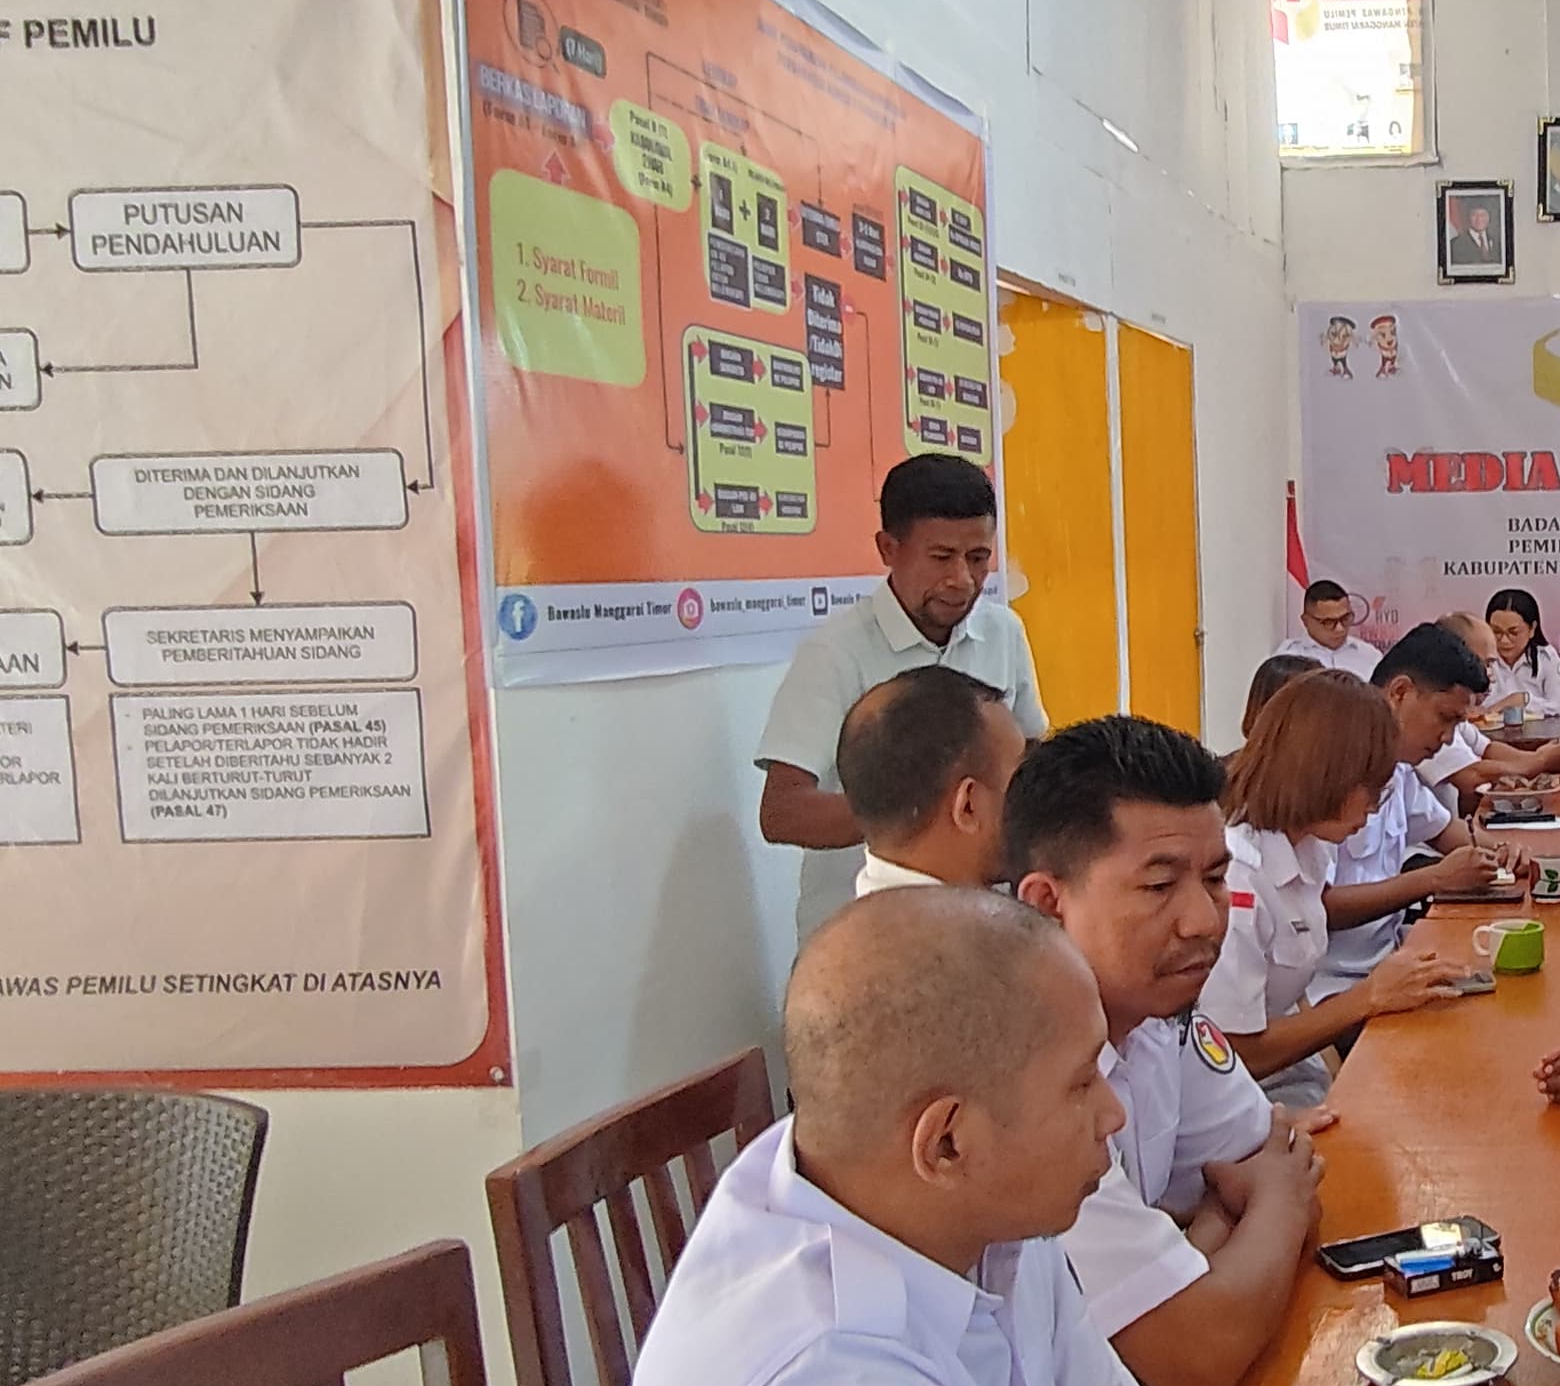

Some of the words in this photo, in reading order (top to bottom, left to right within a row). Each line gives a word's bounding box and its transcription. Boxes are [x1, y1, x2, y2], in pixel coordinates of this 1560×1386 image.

[23, 15, 156, 48] PEMILU
[480, 64, 531, 107] BERKAS
[124, 201, 244, 226] PUTUSAN
[91, 230, 281, 256] PENDAHULUAN
[517, 242, 530, 267] 1.
[533, 245, 577, 280] Syarat
[535, 283, 578, 314] Syarat
[134, 467, 211, 483] DITERIMA
[214, 466, 248, 482] DAN
[251, 464, 361, 481] DILANJUTKAN
[183, 486, 251, 501] DENGAN
[255, 484, 316, 499] SIDANG
[194, 502, 309, 518] PEMERIKSAAN
[1443, 560, 1557, 576] KABUPATEN
[547, 605, 591, 622] Bawaslu
[594, 603, 645, 622] Manggarai
[646, 602, 673, 617] Timur
[146, 629, 245, 644] SEKRETARIS
[249, 626, 375, 643] MENYAMPAIKAN
[162, 646, 297, 663] PEMBERITAHUAN
[300, 644, 362, 660] SIDANG
[142, 707, 195, 721] PALING
[198, 706, 235, 720] LAMA
[251, 705, 286, 719] HARI
[289, 704, 359, 718] SEBELUM
[143, 723, 199, 737] SIDANG
[202, 721, 305, 736] PEMERIKSAAN
[308, 720, 363, 735] (PASAL
[364, 719, 387, 734] 45)
[297, 736, 340, 751] TIDAK
[342, 735, 388, 749] HADIR
[146, 754, 212, 769] SETELAH
[214, 753, 301, 768] DIBERITAHU
[304, 751, 380, 766] SEBANYAK
[383, 751, 393, 765] 2
[147, 770, 179, 784] KALI
[181, 769, 313, 784] BERTURUT-TURUT
[148, 786, 247, 801] DILANJUTKAN
[250, 785, 305, 800] SIDANG
[308, 784, 411, 799] PEMERIKSAAN
[150, 804, 203, 819] (PASAL
[0, 977, 59, 998] WAS
[66, 974, 157, 996] PEMILU
[163, 972, 299, 995] SETINGKAT
[303, 971, 326, 993] DI
[331, 970, 442, 992] ATASNYA
